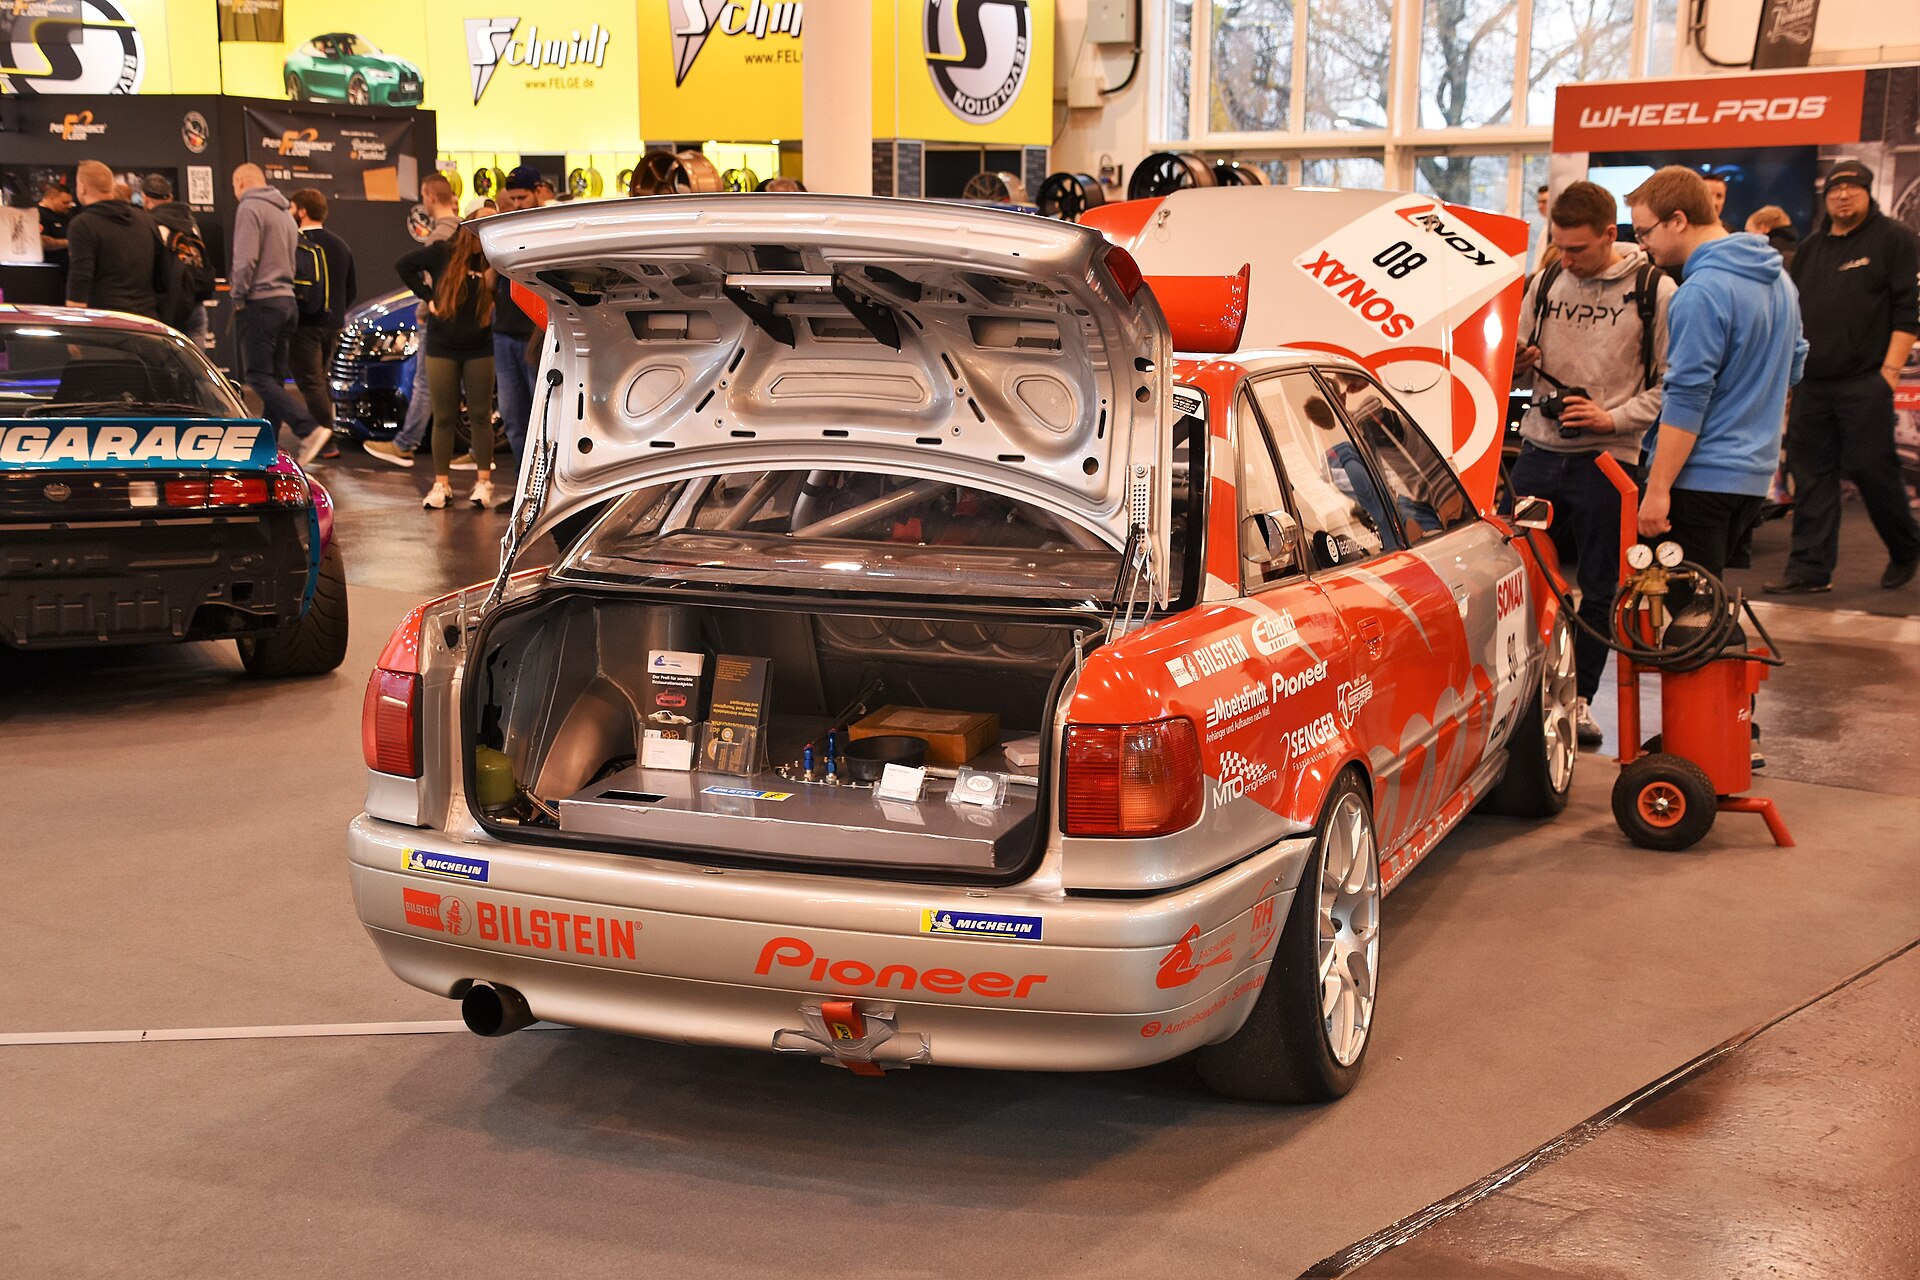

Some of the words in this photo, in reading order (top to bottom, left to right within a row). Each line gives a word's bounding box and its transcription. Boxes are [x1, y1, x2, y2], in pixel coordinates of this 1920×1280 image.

[471, 23, 610, 70] Schmidt
[744, 49, 803, 64] www.FEL
[525, 78, 594, 89] www.FELGE.de
[952, 35, 1027, 115] REVOLUTION
[1579, 102, 1709, 128] WHEEL
[1712, 96, 1827, 123] PROS
[1372, 241, 1428, 279] 80
[1302, 250, 1415, 338] SONAX
[1497, 570, 1525, 622] SONAX
[1251, 608, 1300, 656] Eibach
[1193, 634, 1250, 677] BILSTEIN
[1271, 660, 1329, 703] Pioneer
[1291, 712, 1340, 759] SENGER
[1292, 752, 1325, 771] Faszination
[1213, 775, 1245, 809] MTO
[1244, 769, 1277, 794] engineering
[426, 858, 482, 875] MICHELIN
[405, 901, 438, 917] BILSTEIN
[955, 918, 1033, 933] MICHELIN
[1250, 896, 1275, 932] RH
[754, 937, 1048, 998] Pioneer
